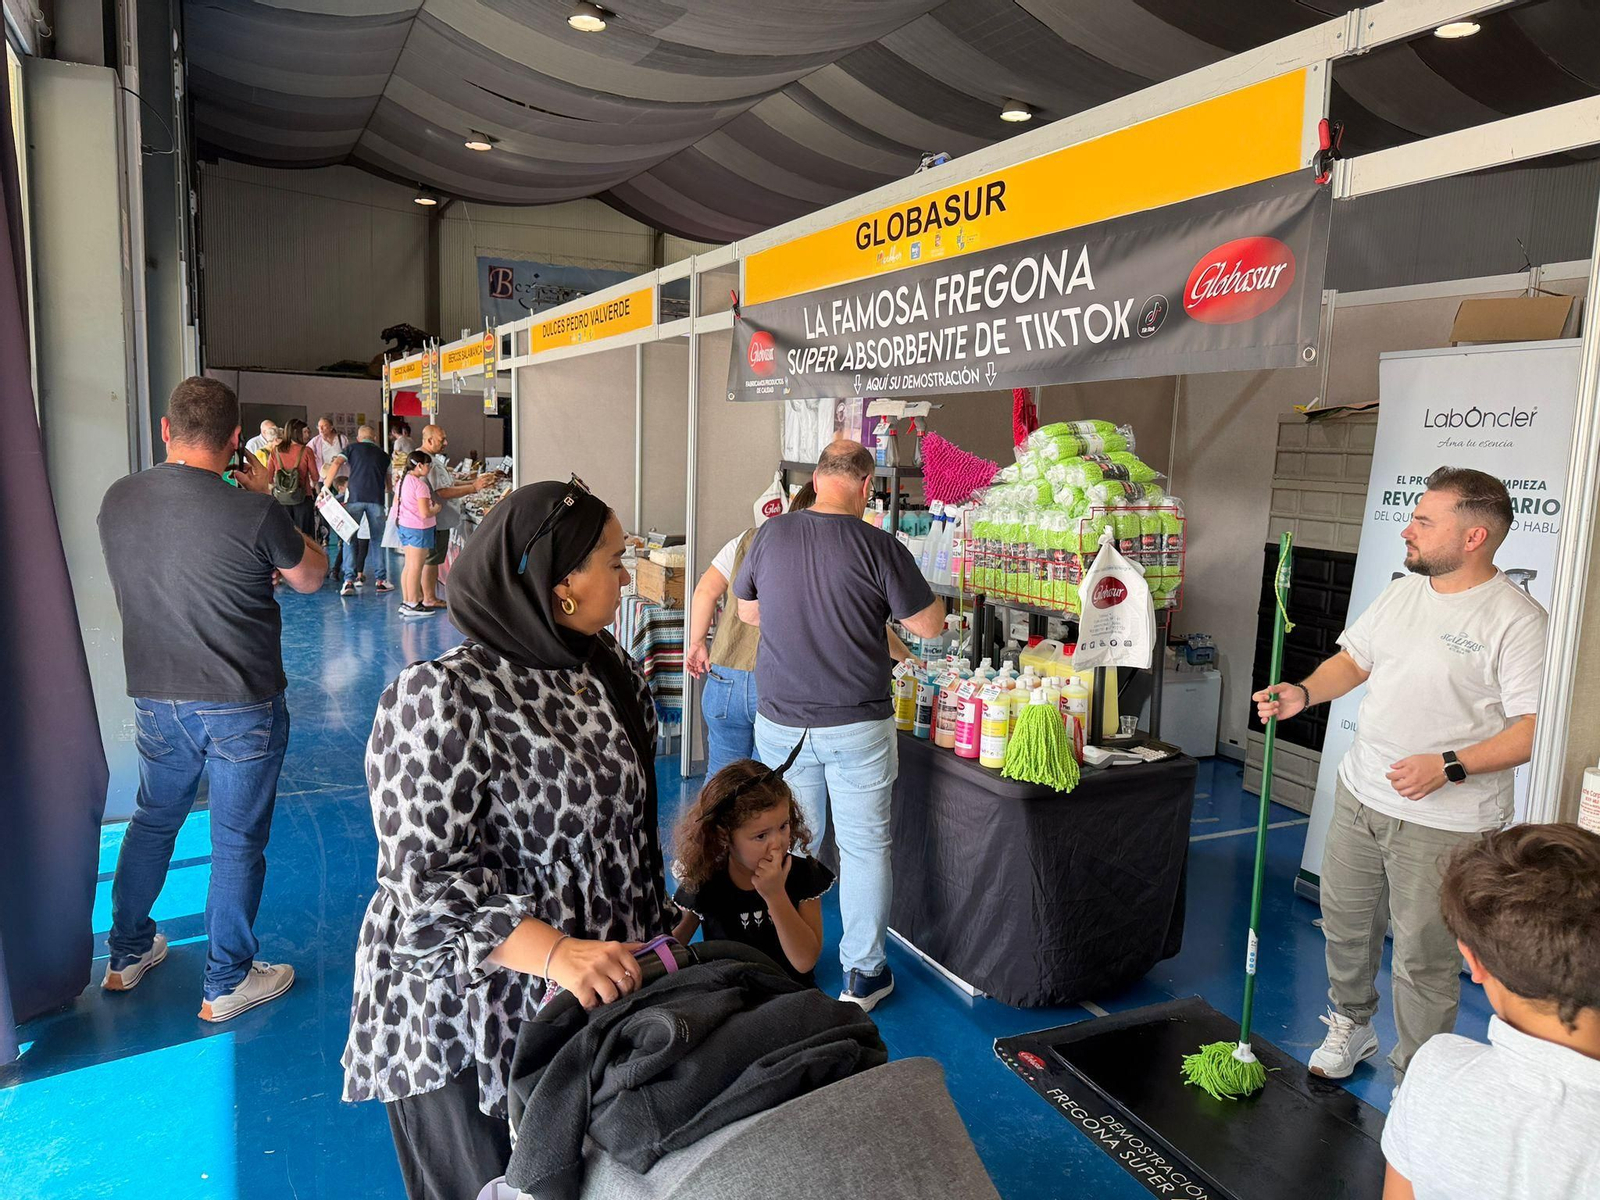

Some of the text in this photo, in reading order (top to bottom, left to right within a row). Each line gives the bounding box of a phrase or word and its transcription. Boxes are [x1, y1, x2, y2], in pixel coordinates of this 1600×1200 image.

[856, 180, 1006, 250] GLOBASUR
[803, 303, 828, 340] LA
[831, 282, 928, 336] FAMOSA
[934, 244, 1096, 318] FREGONA
[1186, 259, 1288, 309] Globasur
[542, 298, 630, 338] DULCES PEDRO VALVERDE
[786, 298, 1135, 375] SUPER ABSORBENTE DE TIKTOK
[865, 366, 980, 391] AQUÍ SU DEMOSTRACIÓN
[1466, 438, 1476, 447] tu
[1478, 438, 1514, 448] esencia
[1396, 475, 1547, 491] EL PRO MPIEZA
[1374, 510, 1390, 521] DEL
[1046, 1087, 1175, 1194] FREGONA SUPER
